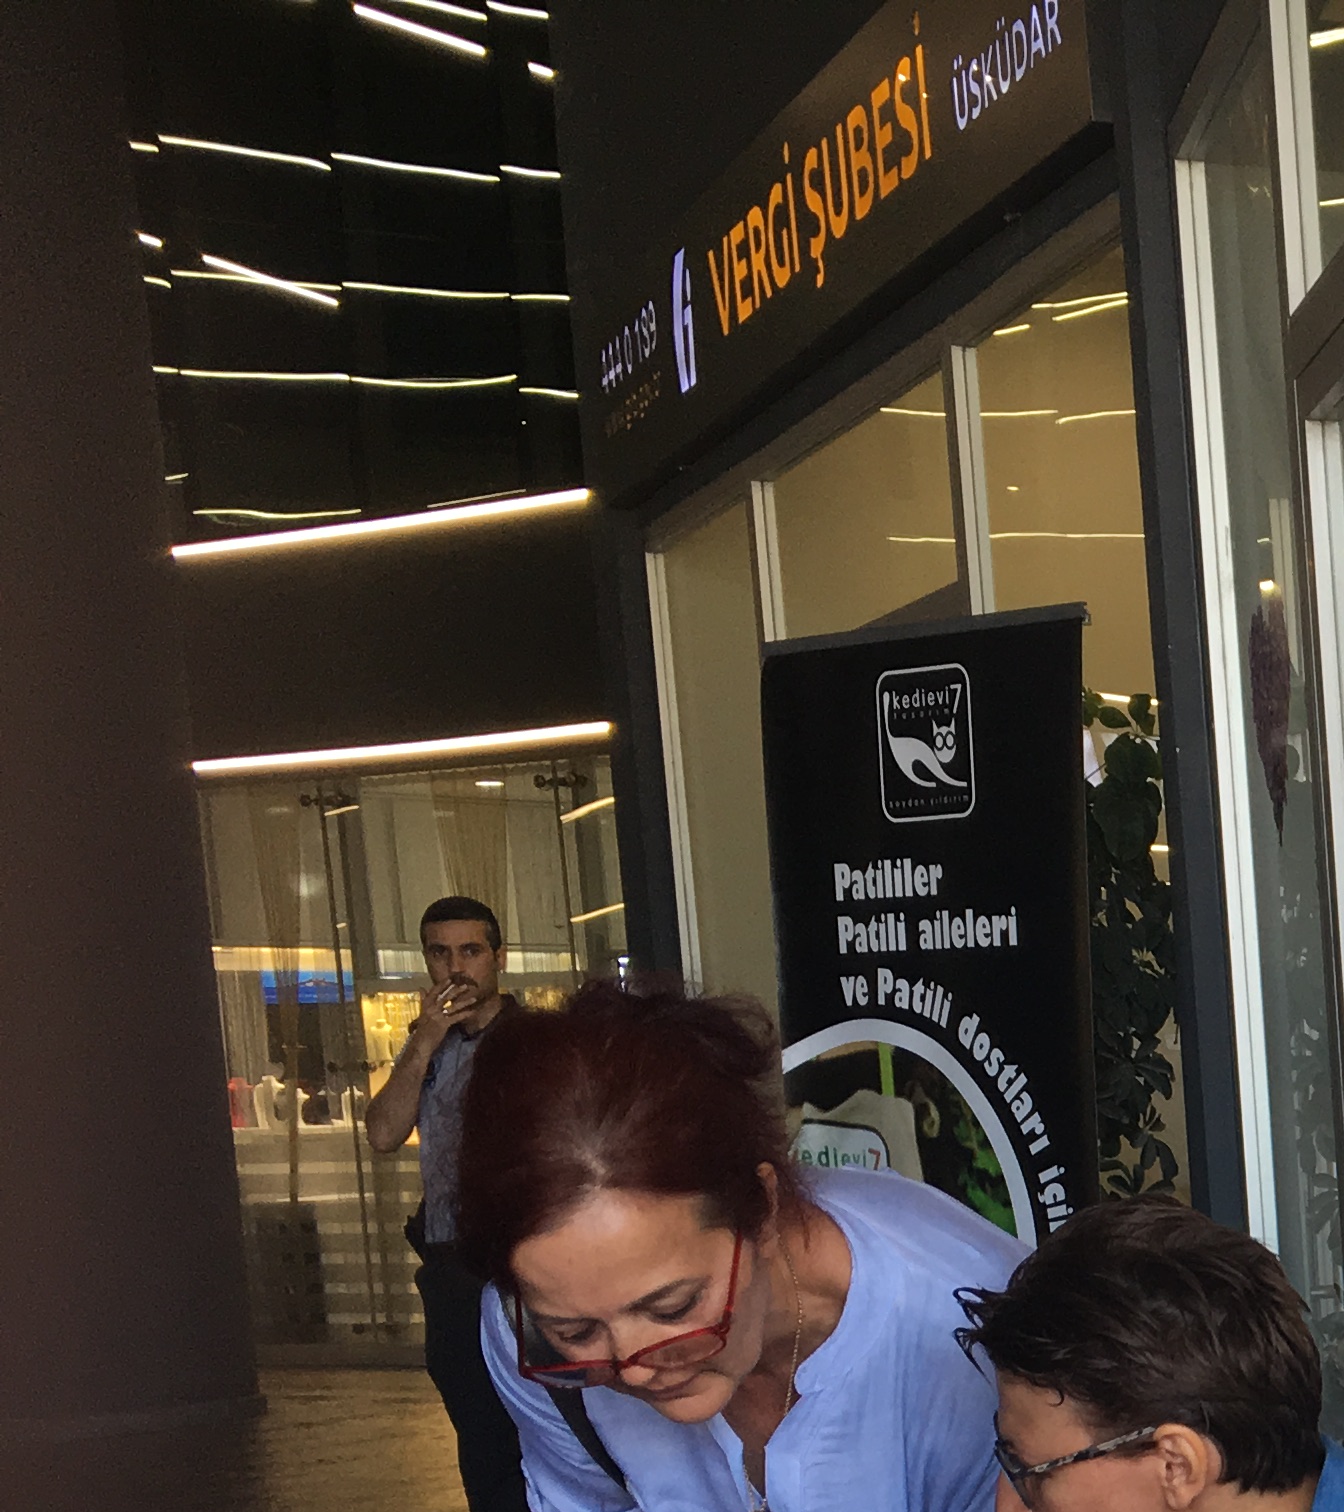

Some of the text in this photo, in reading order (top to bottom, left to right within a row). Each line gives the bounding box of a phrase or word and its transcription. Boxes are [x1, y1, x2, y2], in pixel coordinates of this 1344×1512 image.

[708, 141, 800, 336] VERGİ
[803, 11, 932, 288] ŞUBESİ
[952, 0, 1062, 130] ÜSKÜDAR
[892, 683, 962, 714] kedievi7
[833, 858, 943, 901] Patililer
[836, 906, 1018, 954] Patili aileleri
[840, 974, 869, 1007] ve
[877, 967, 952, 1028] Patili
[957, 1012, 1051, 1156] dostları
[797, 1145, 881, 1171] edievi7
